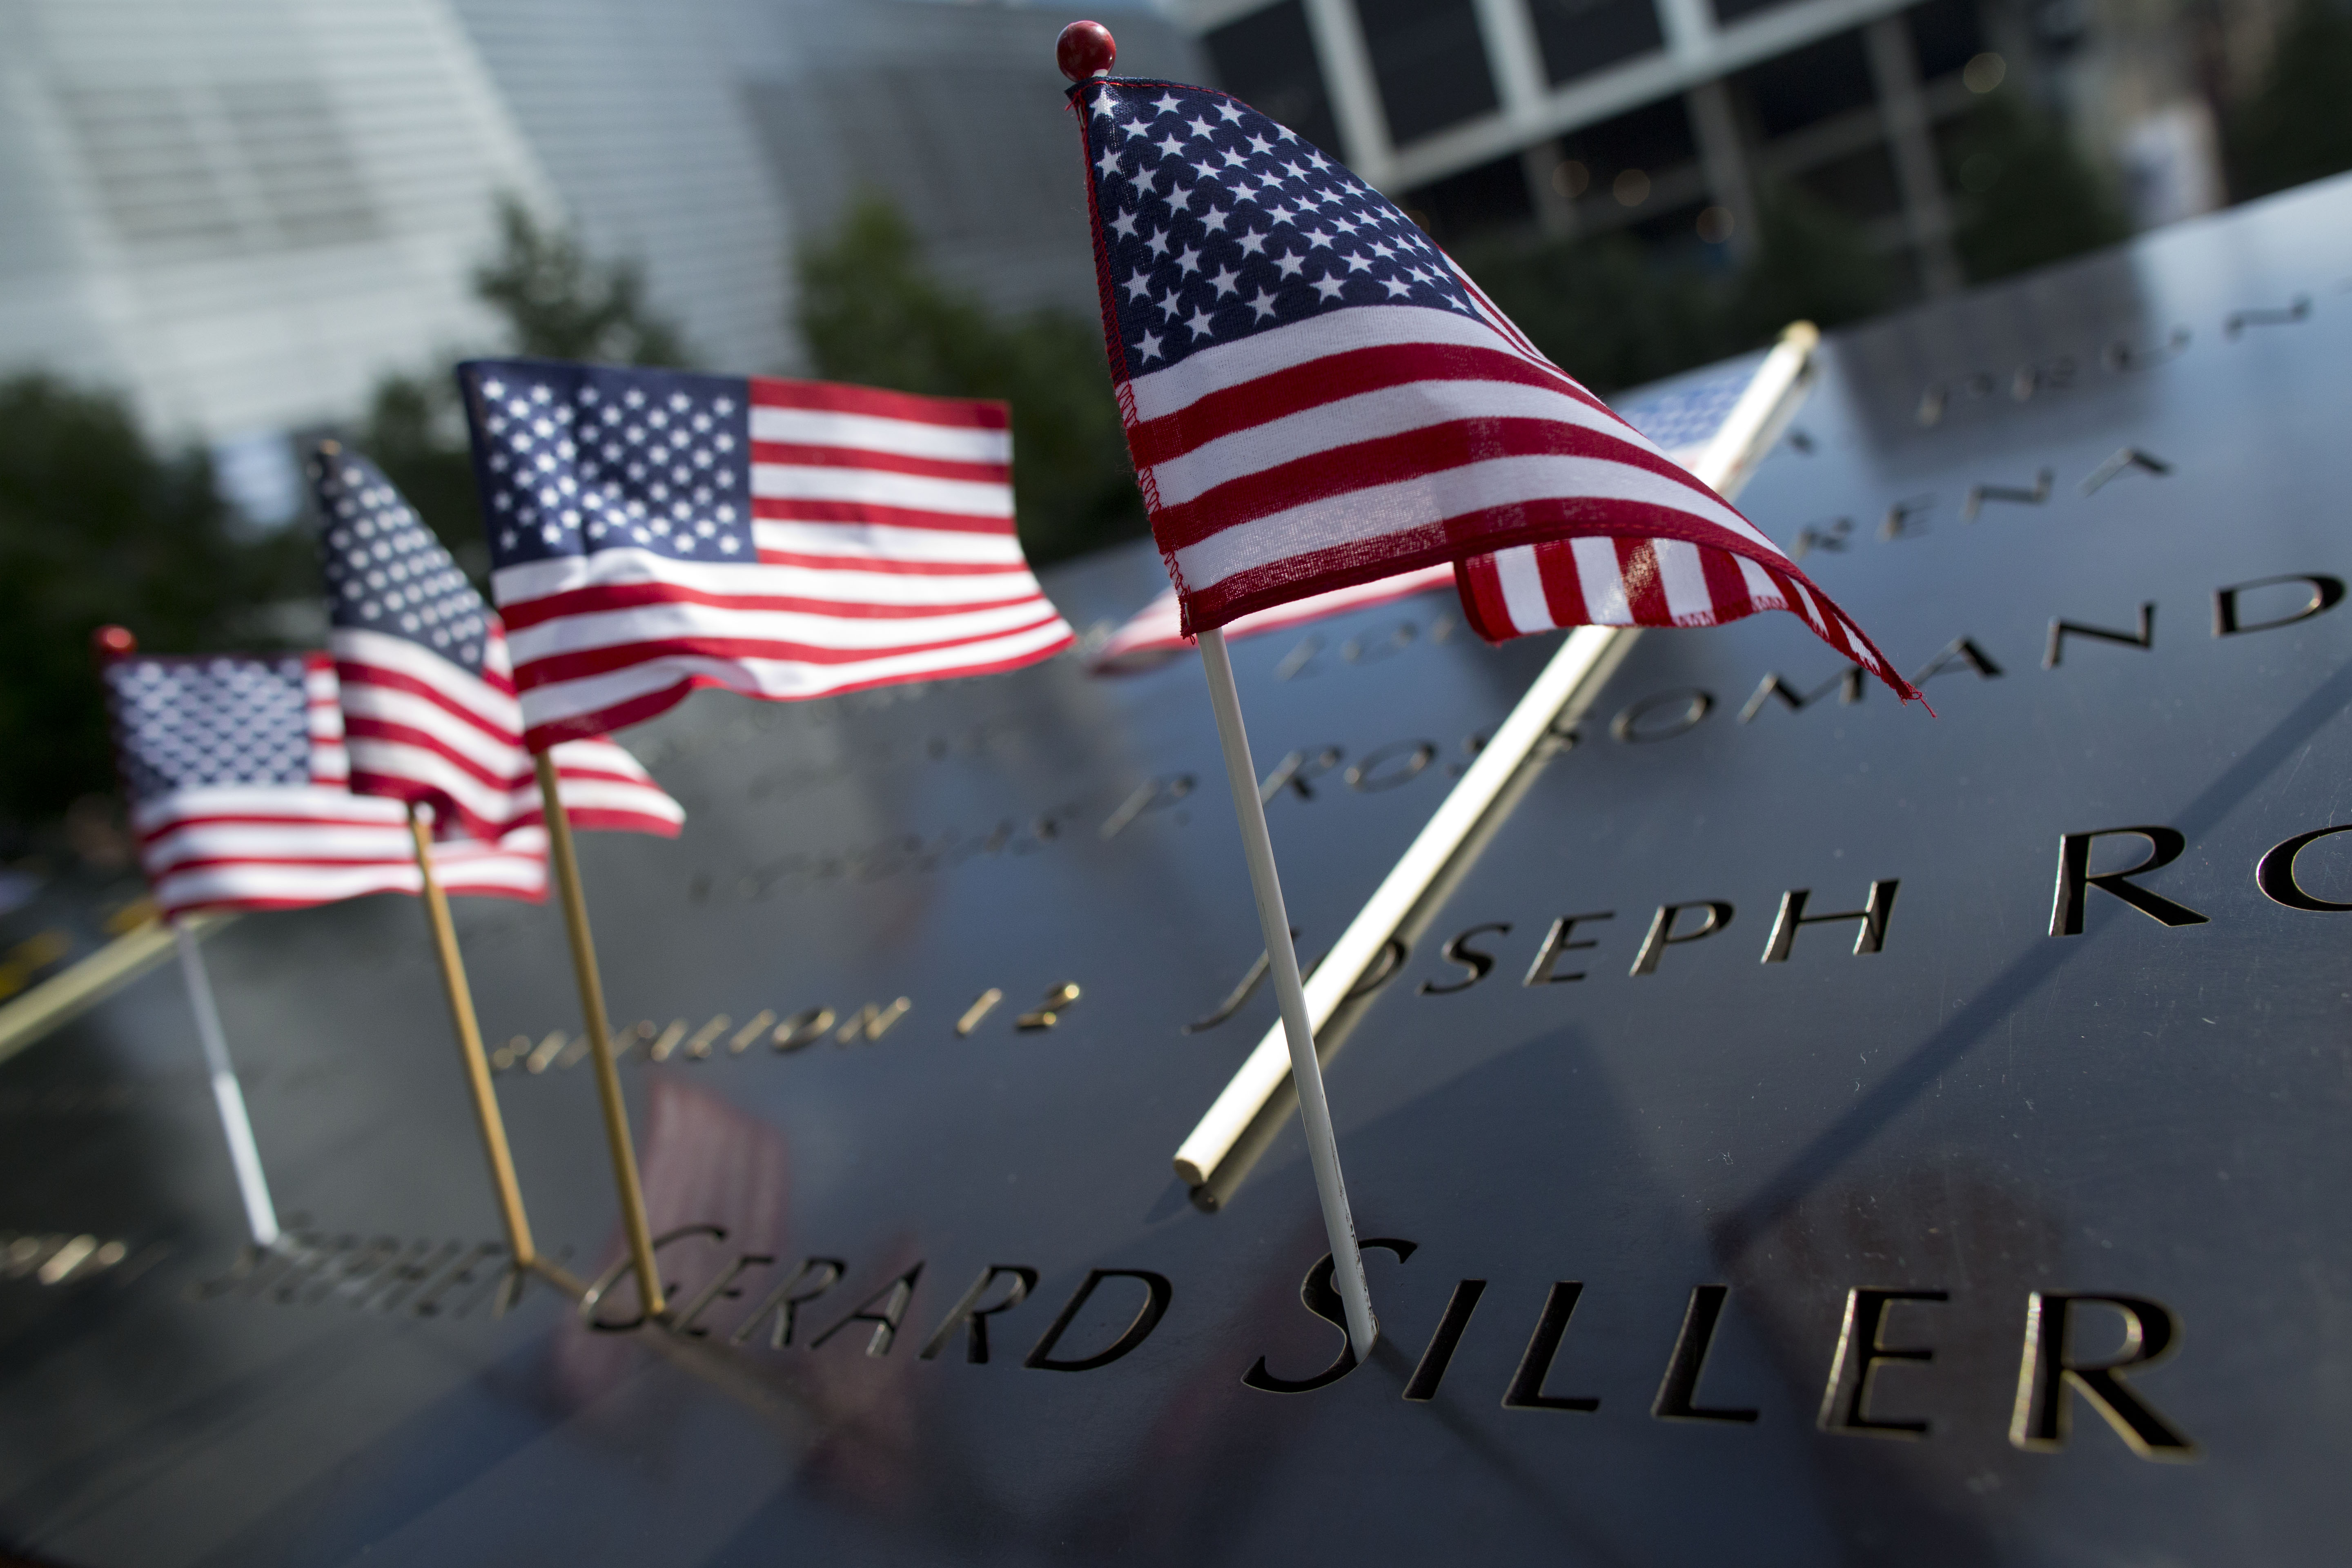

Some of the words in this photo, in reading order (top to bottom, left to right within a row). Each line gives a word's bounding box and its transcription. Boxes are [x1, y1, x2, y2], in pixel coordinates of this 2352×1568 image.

[1260, 572, 2346, 808] ROOMAND
[577, 1225, 1173, 1373] GERARD
[1241, 1236, 2200, 1461] SILLER
